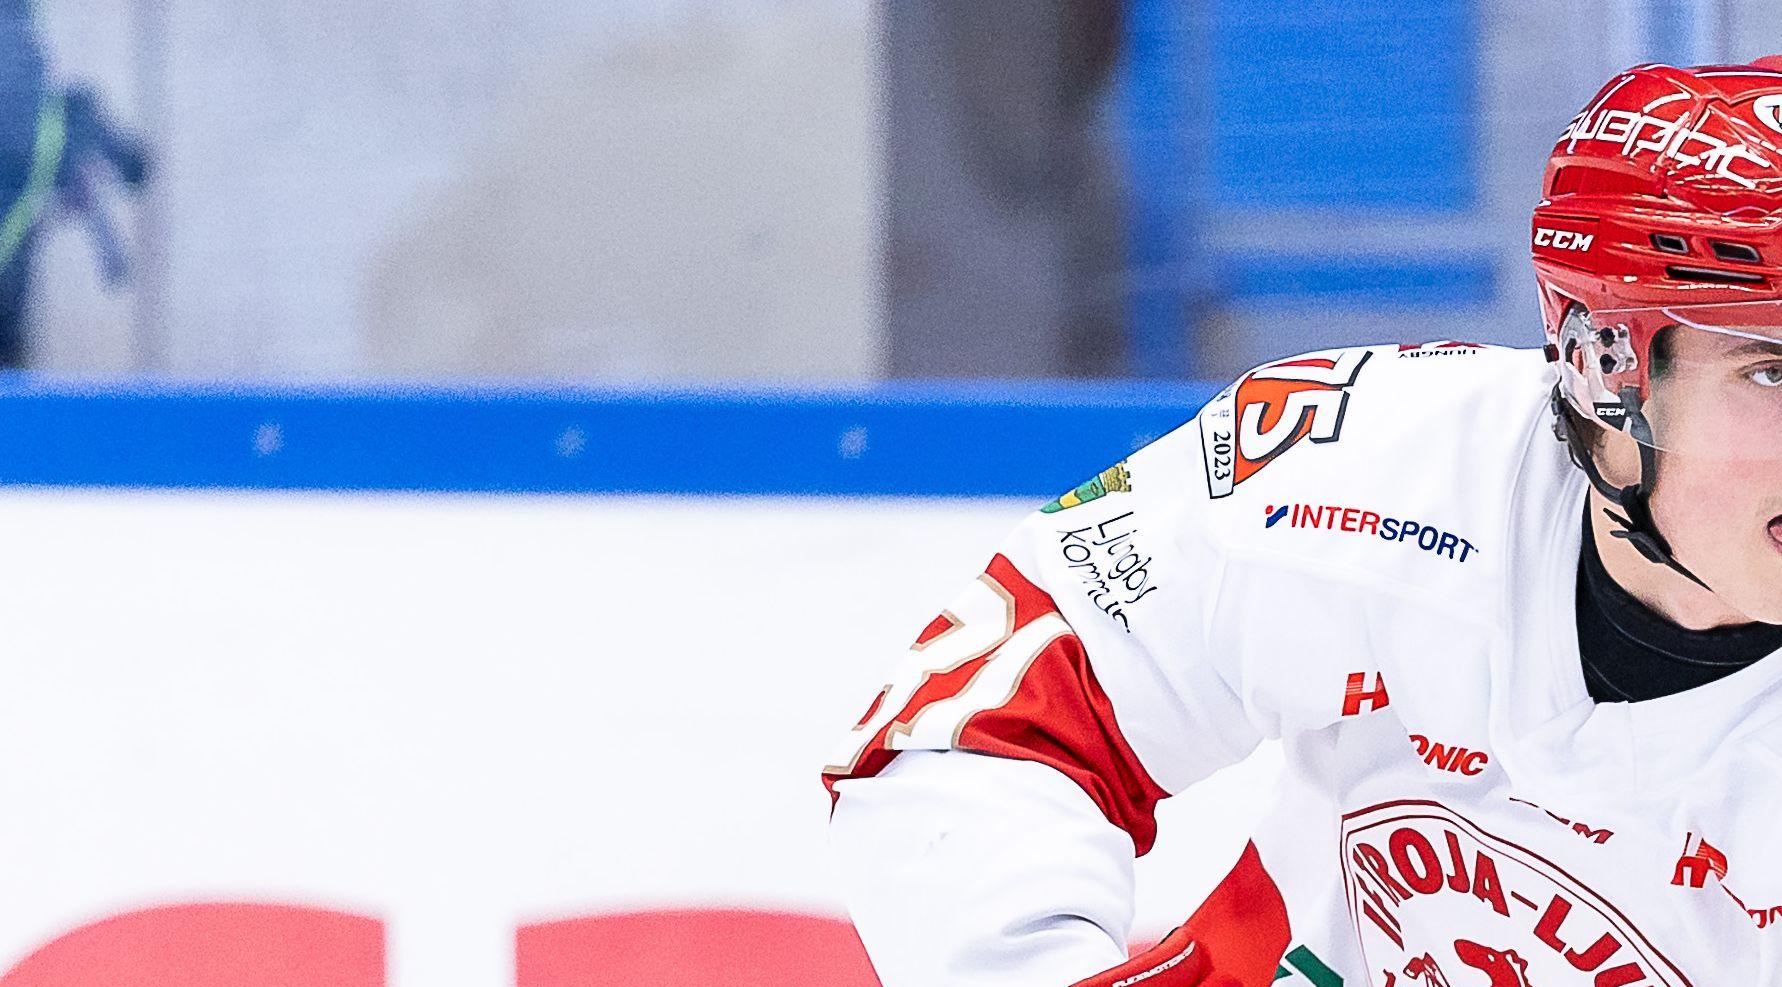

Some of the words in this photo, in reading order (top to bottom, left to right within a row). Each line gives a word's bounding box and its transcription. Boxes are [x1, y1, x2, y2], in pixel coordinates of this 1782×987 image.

[1533, 227, 1595, 252] CCM
[1597, 408, 1626, 416] CCM
[1213, 431, 1231, 481] 2023
[1291, 504, 1474, 563] INTERSPORT
[1408, 734, 1488, 776] ONIC
